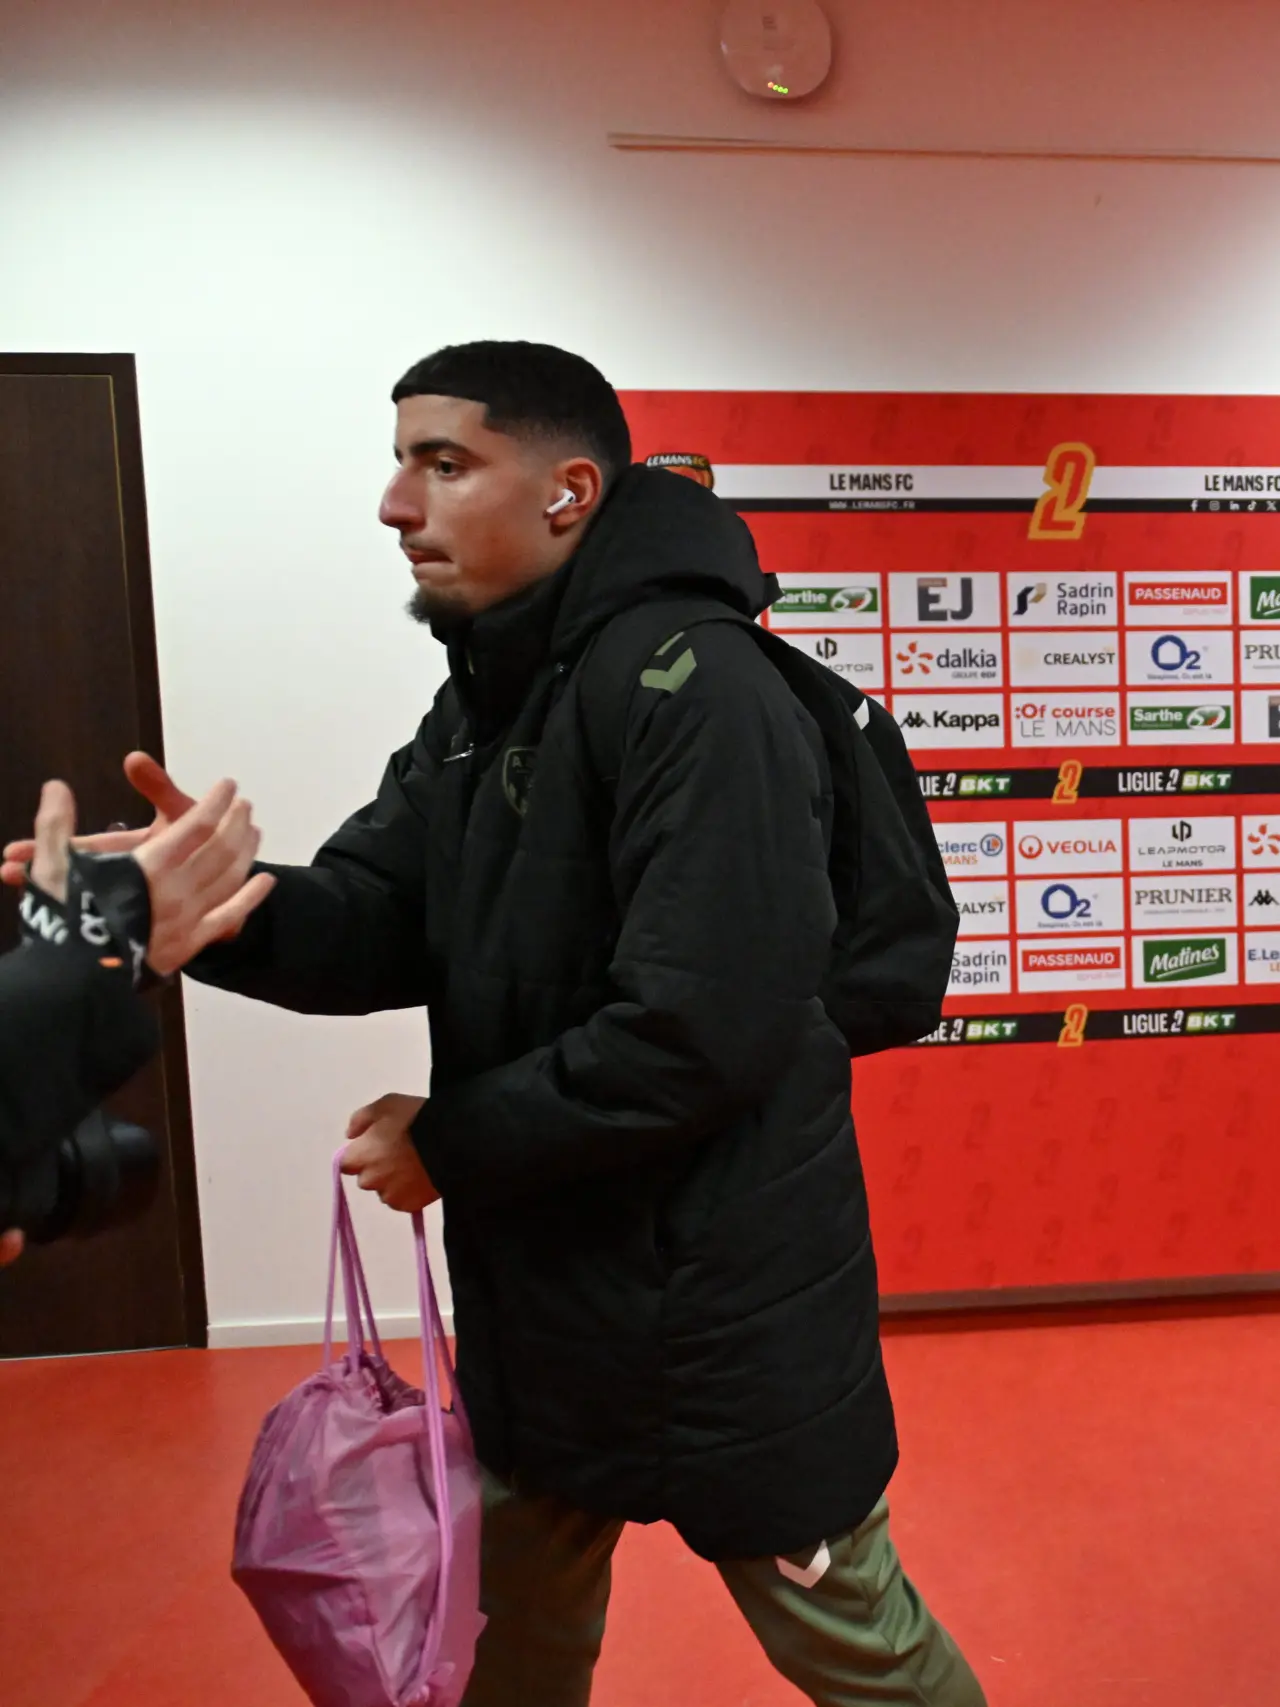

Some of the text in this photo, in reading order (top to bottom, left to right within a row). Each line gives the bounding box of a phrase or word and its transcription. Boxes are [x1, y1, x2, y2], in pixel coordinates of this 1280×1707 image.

[829, 473, 913, 491] LE MANS FC
[1204, 475, 1220, 491] LE
[1223, 475, 1264, 491] MANS
[1057, 583, 1113, 598] Sadrin
[1135, 588, 1221, 600] PASSENAUD
[917, 577, 974, 621] EJ
[1057, 601, 1106, 617] Rapin
[936, 648, 997, 668] dalkia
[1044, 653, 1115, 665] CREALYST
[1052, 705, 1115, 718] course
[1133, 709, 1183, 722] Sarthe
[933, 711, 999, 731] Kappa
[1020, 720, 1116, 738] LE MANS
[943, 773, 957, 796] 2
[960, 778, 1010, 792] BKT
[1118, 769, 1231, 792] LIGUE 2 BKT
[938, 841, 977, 854] clerc
[1047, 841, 1117, 854] VEOLIA
[1138, 845, 1226, 855] LEAPMOTOR
[1135, 888, 1232, 905] PRUNIER
[955, 901, 1006, 914] EALYST
[951, 951, 1007, 967] Sadrin
[1028, 952, 1115, 967] PASSENAUD
[1150, 944, 1219, 975] Matines
[951, 969, 1000, 985] Rapin
[950, 1019, 964, 1041] 2
[966, 1022, 1017, 1036] BKT
[1123, 1010, 1236, 1034] LIGUE 2 BKT
